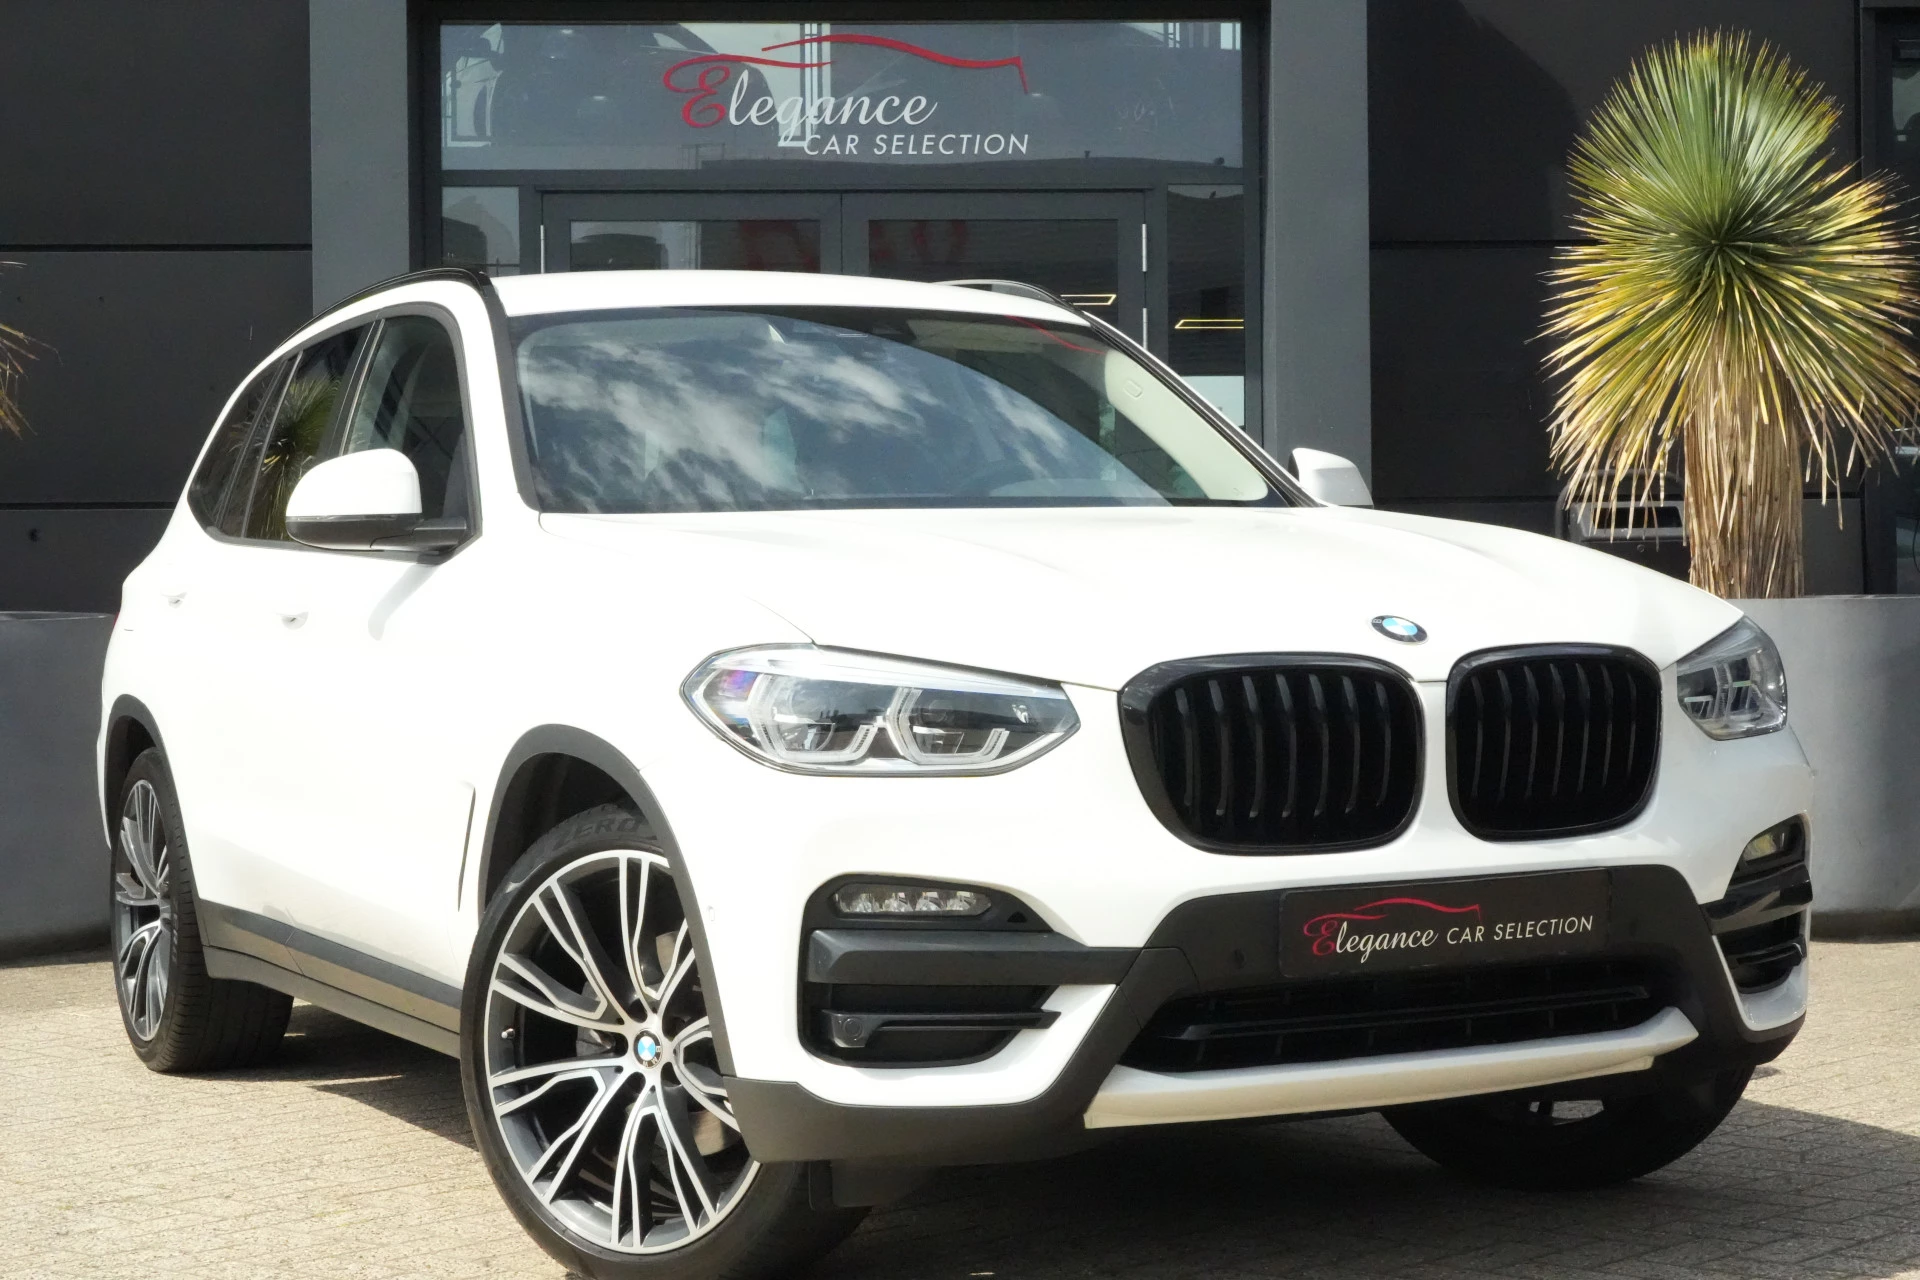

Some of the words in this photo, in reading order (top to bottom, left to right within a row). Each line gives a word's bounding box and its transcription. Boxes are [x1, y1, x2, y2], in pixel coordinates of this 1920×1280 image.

[663, 53, 938, 144] Elegance
[804, 134, 858, 155] CAR
[873, 134, 1028, 155] SELECTION
[1303, 914, 1439, 963] Elegance
[1446, 925, 1485, 945] CAR
[1493, 915, 1593, 941] SELECTION
